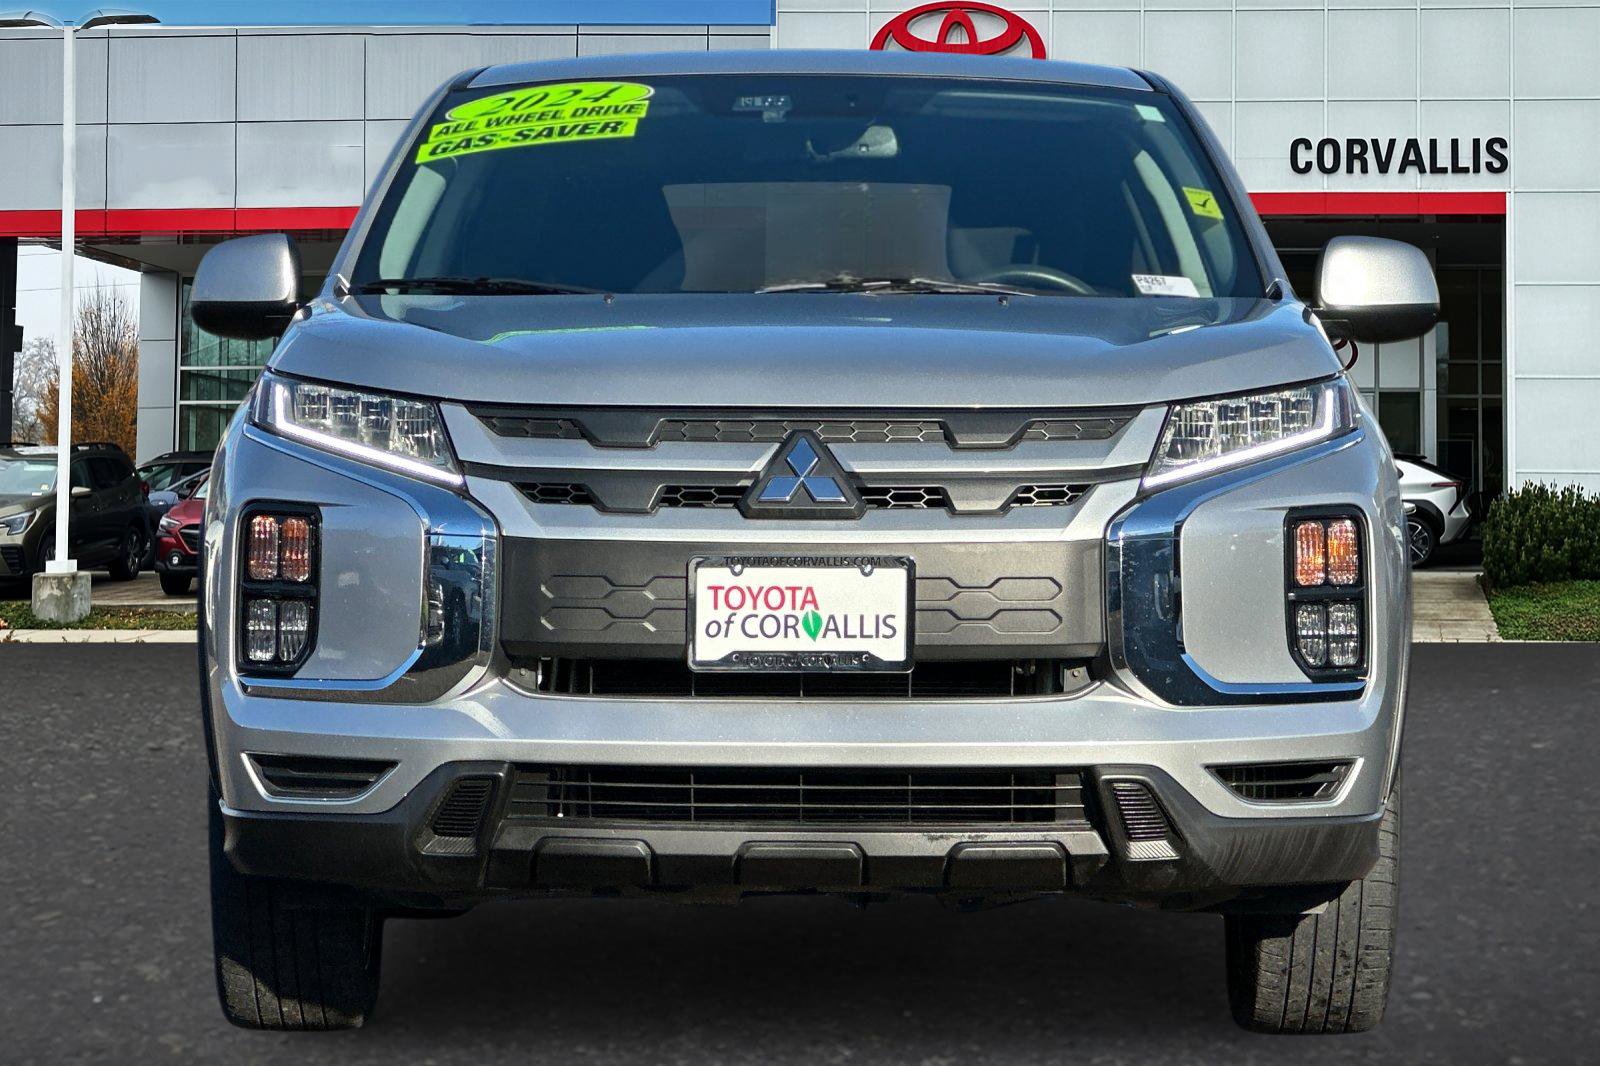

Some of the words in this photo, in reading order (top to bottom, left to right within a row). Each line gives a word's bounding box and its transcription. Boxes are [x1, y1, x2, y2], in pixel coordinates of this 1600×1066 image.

[474, 85, 624, 118] 2024
[434, 121, 478, 137] ALL
[485, 109, 565, 128] WHEEL
[570, 103, 646, 118] DRIVE
[1289, 137, 1509, 174] CORVALLIS
[707, 585, 820, 611] TOYOTA
[705, 612, 737, 639] of
